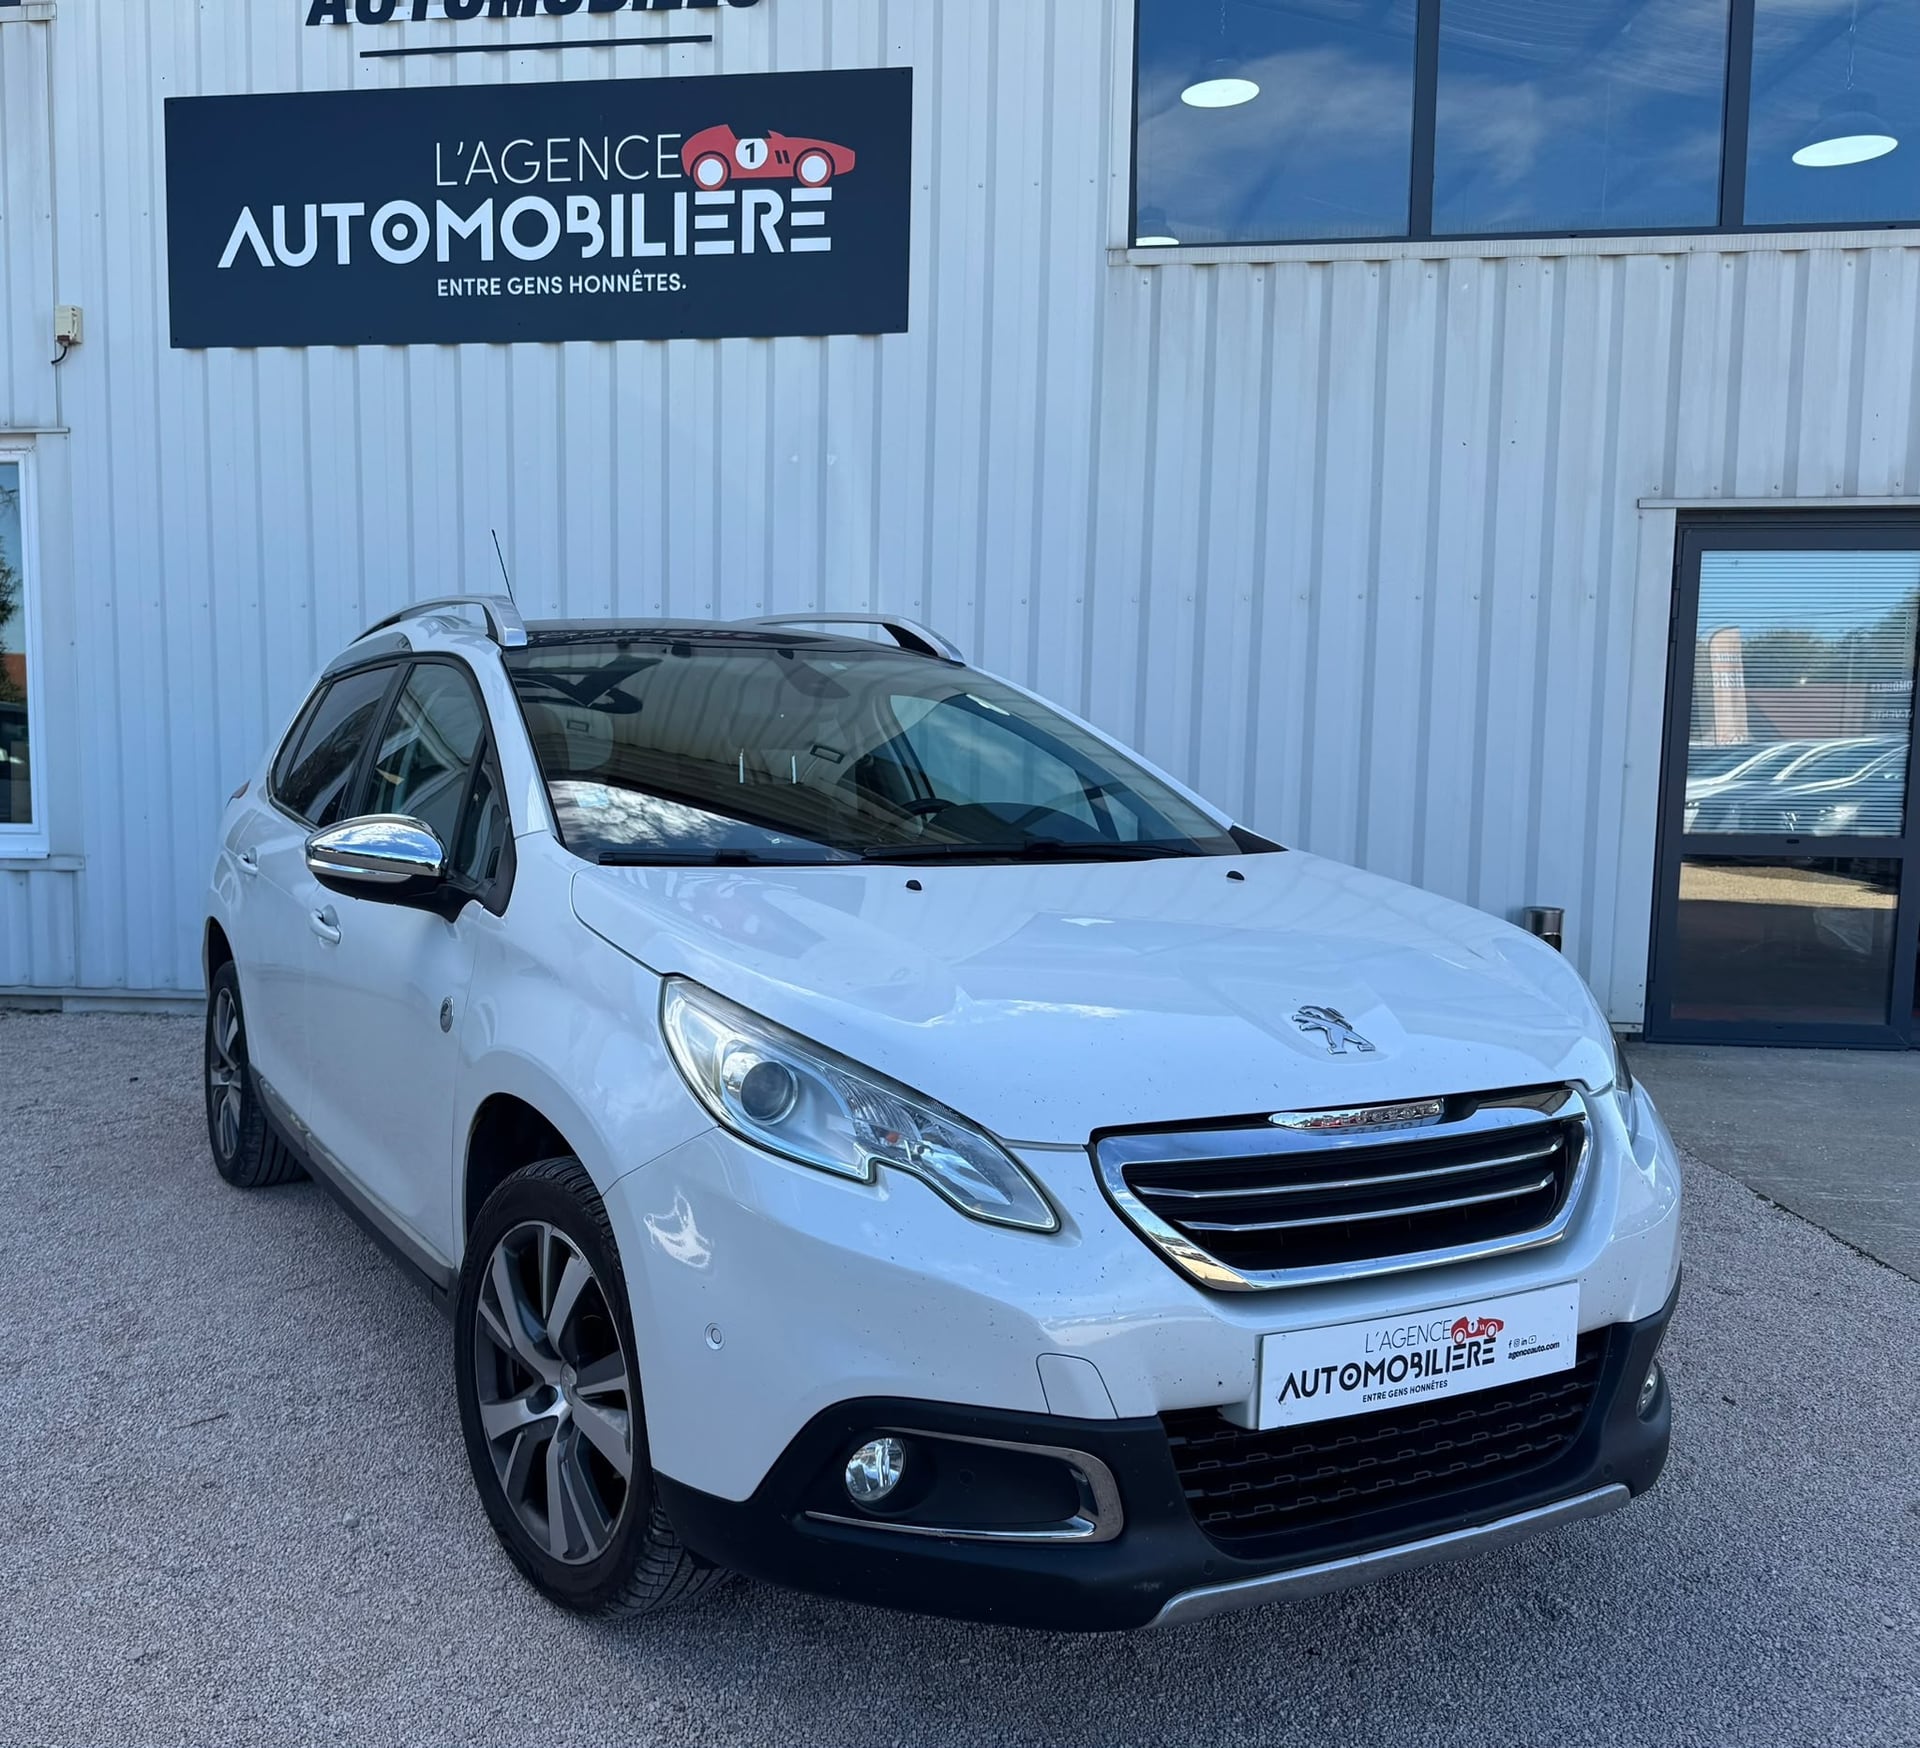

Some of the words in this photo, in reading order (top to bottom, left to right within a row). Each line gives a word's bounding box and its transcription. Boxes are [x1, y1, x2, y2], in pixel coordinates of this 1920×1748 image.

[436, 133, 682, 186] L'AGENCE
[437, 277, 501, 297] ENTRE
[507, 276, 563, 296] GENS
[568, 269, 687, 294] HONNÊTES.
[1365, 1320, 1451, 1353] L'AGENCE
[1362, 1392, 1386, 1402] ENTRE
[1387, 1387, 1408, 1398] GENS
